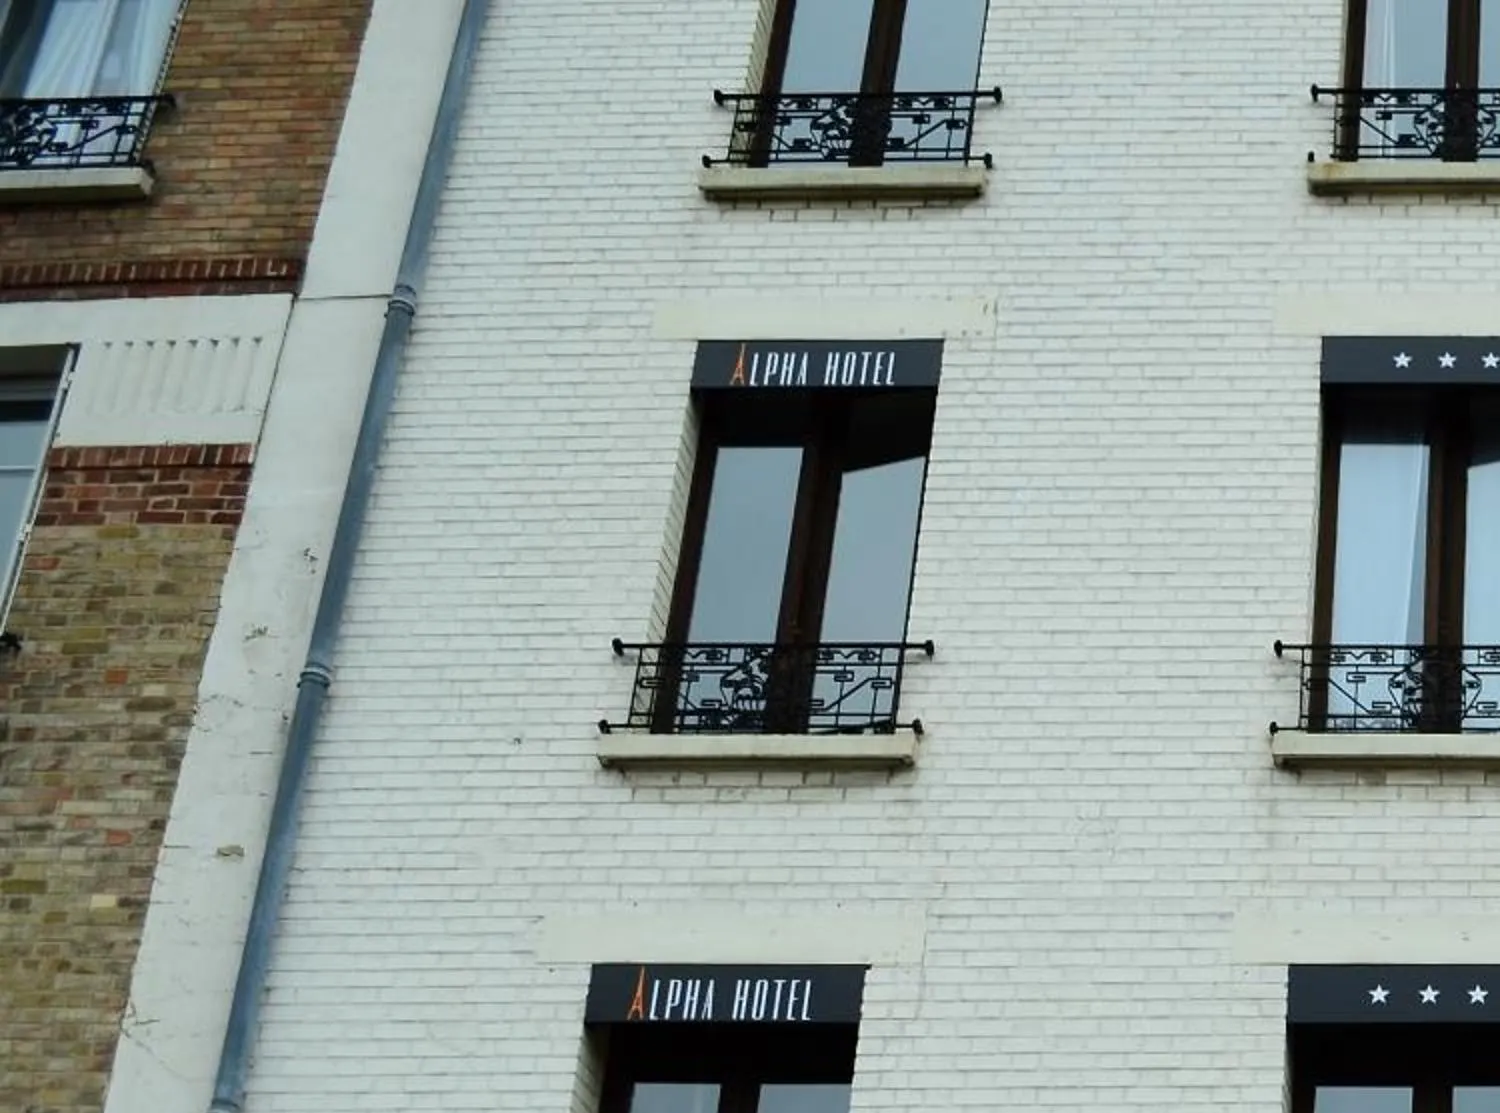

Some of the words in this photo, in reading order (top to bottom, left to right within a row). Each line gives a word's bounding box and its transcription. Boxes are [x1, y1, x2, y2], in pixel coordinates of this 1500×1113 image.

[730, 343, 808, 386] ALPHA
[824, 351, 896, 386] HOTEL
[627, 966, 715, 1021] ALPHA
[731, 978, 812, 1021] HOTEL
